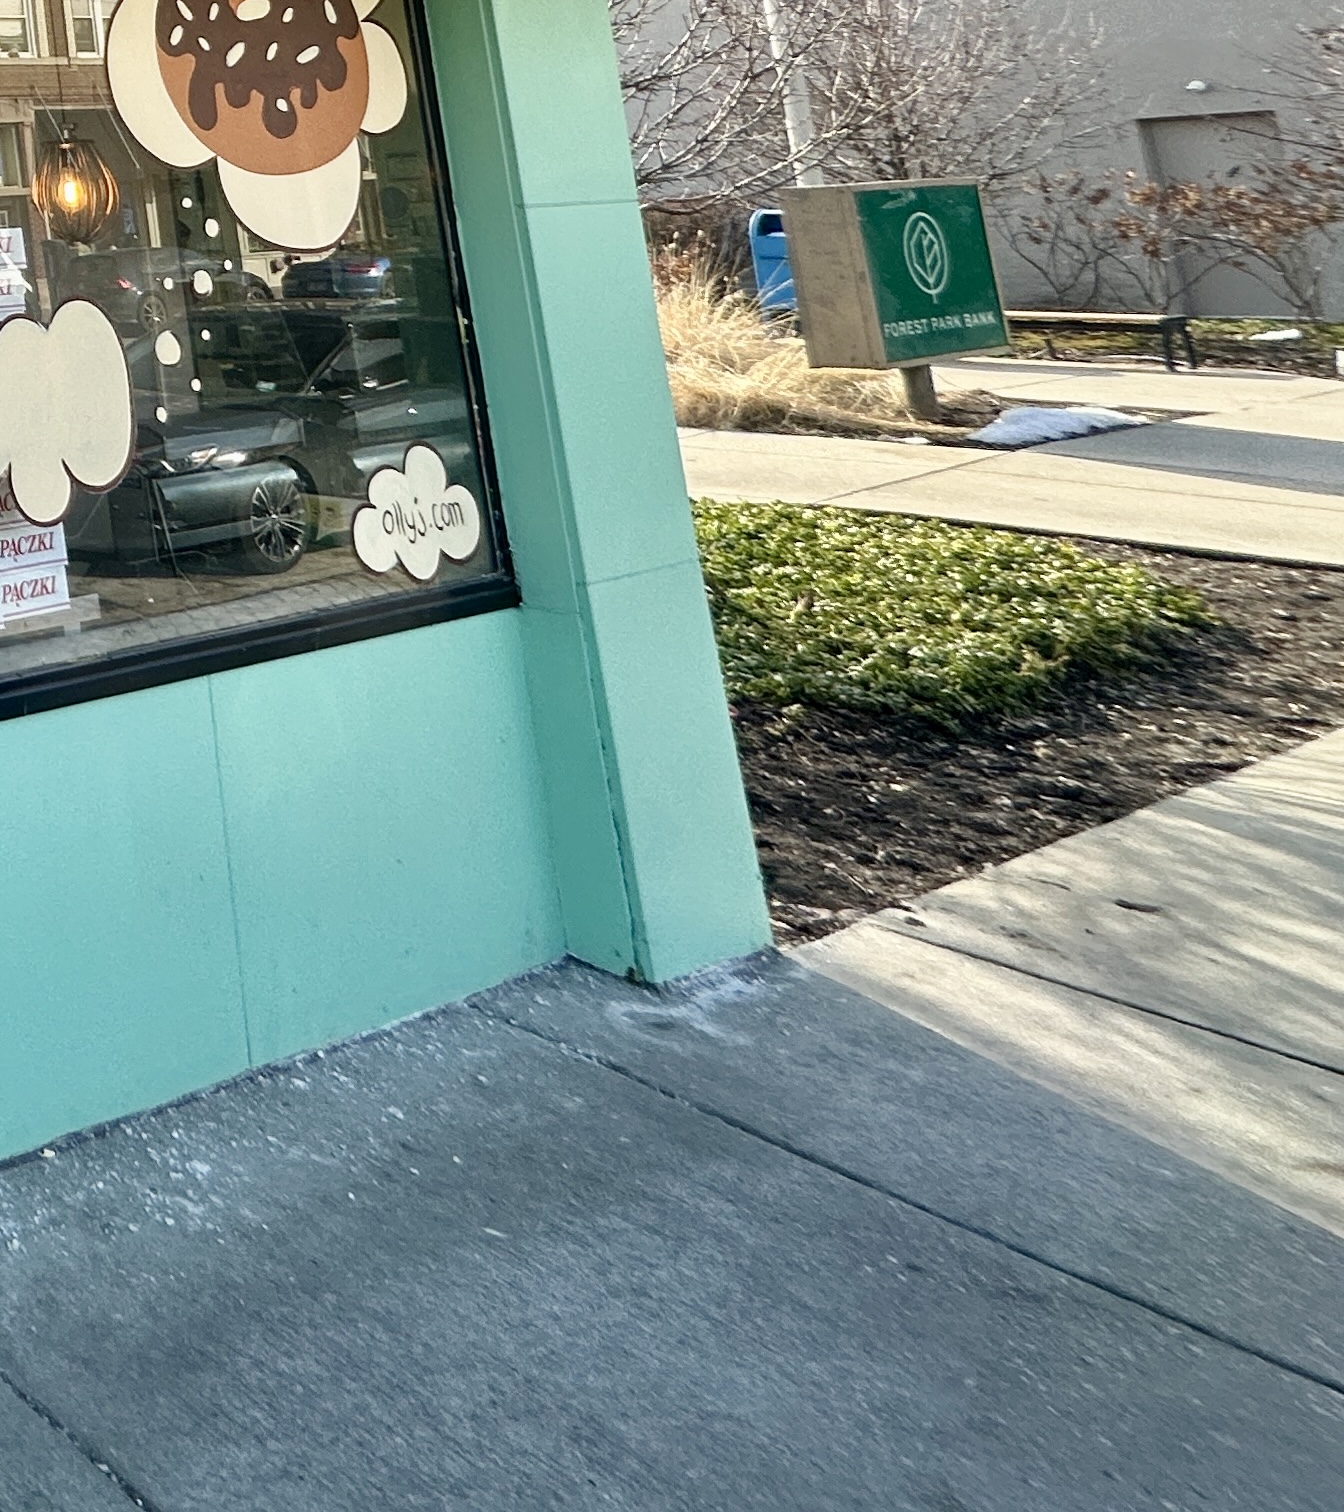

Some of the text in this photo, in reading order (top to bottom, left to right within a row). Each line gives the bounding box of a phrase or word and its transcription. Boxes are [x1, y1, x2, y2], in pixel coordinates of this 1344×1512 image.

[883, 311, 997, 338] FOREST PARK BANK
[1, 576, 57, 607] PĄCZKI
